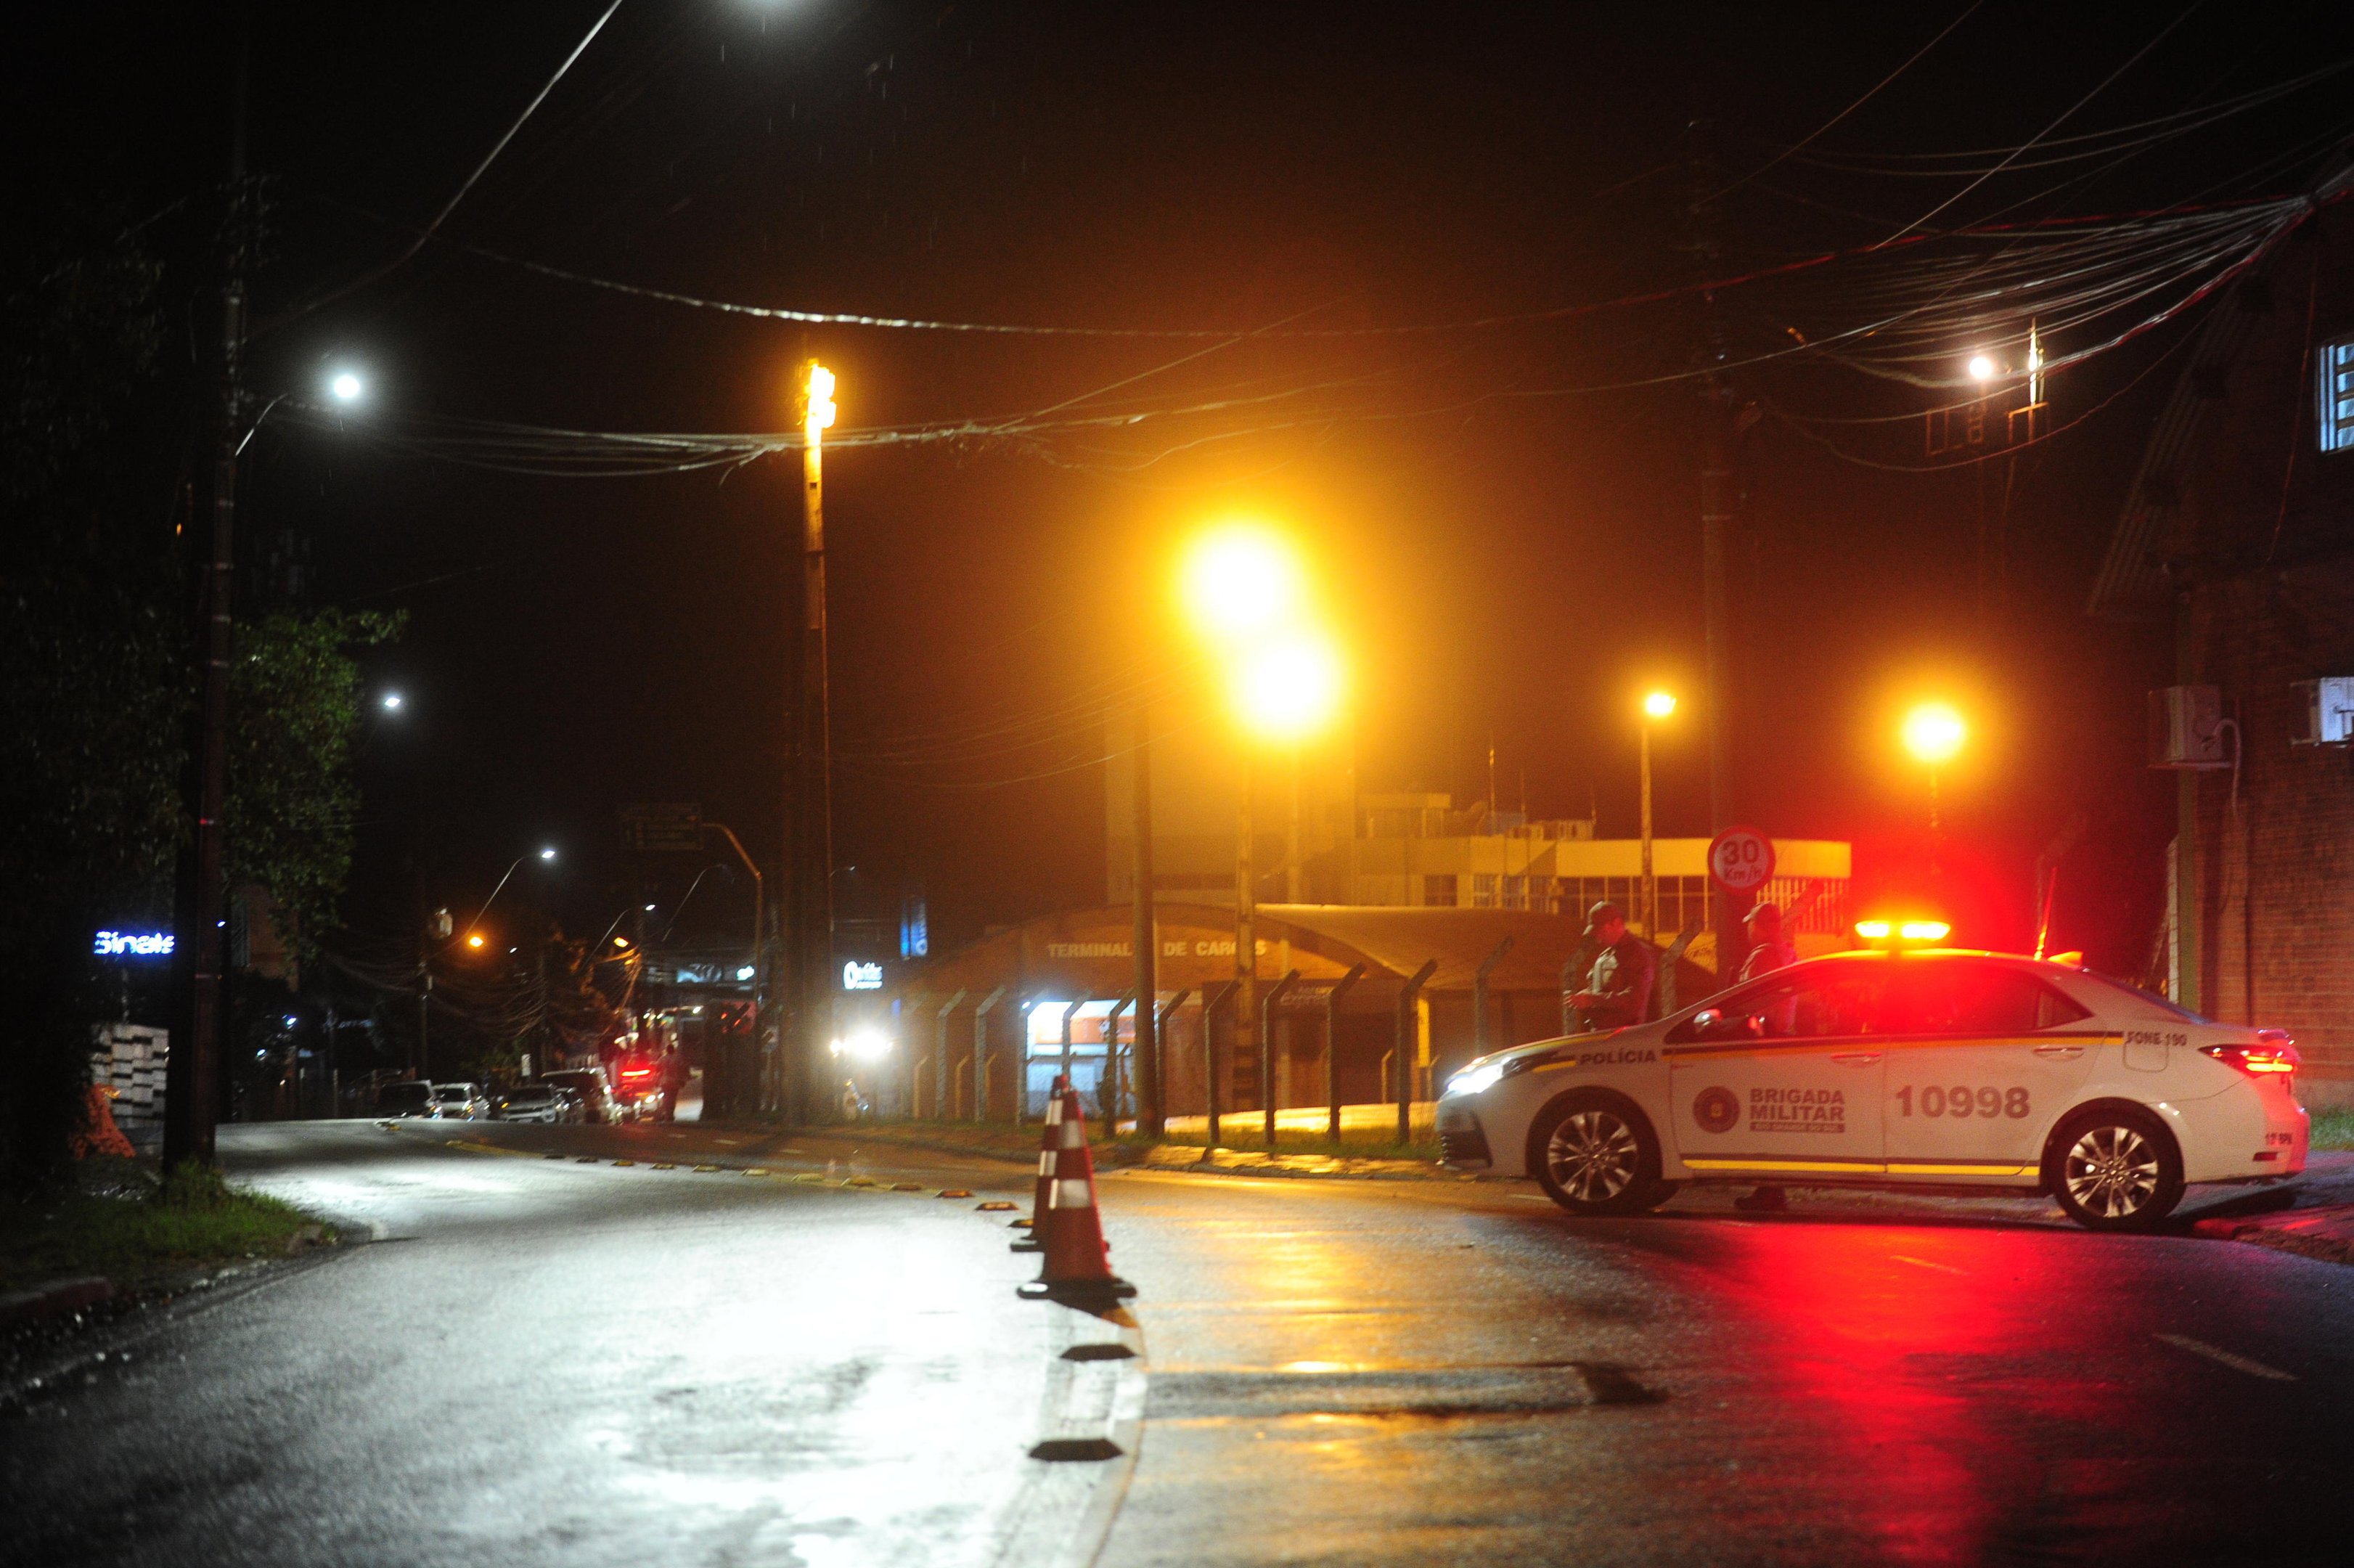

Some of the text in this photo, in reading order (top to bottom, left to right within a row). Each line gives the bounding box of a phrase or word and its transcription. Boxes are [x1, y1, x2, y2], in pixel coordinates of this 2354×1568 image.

[1722, 840, 1759, 865] 30
[1049, 939, 1267, 957] TERMINAL DE CARS
[1579, 1048, 1656, 1066] POLÍCIA
[1750, 1088, 1845, 1103] BRIGADA
[1895, 1085, 2031, 1119] 10998
[1750, 1105, 1844, 1121] MILITAR
